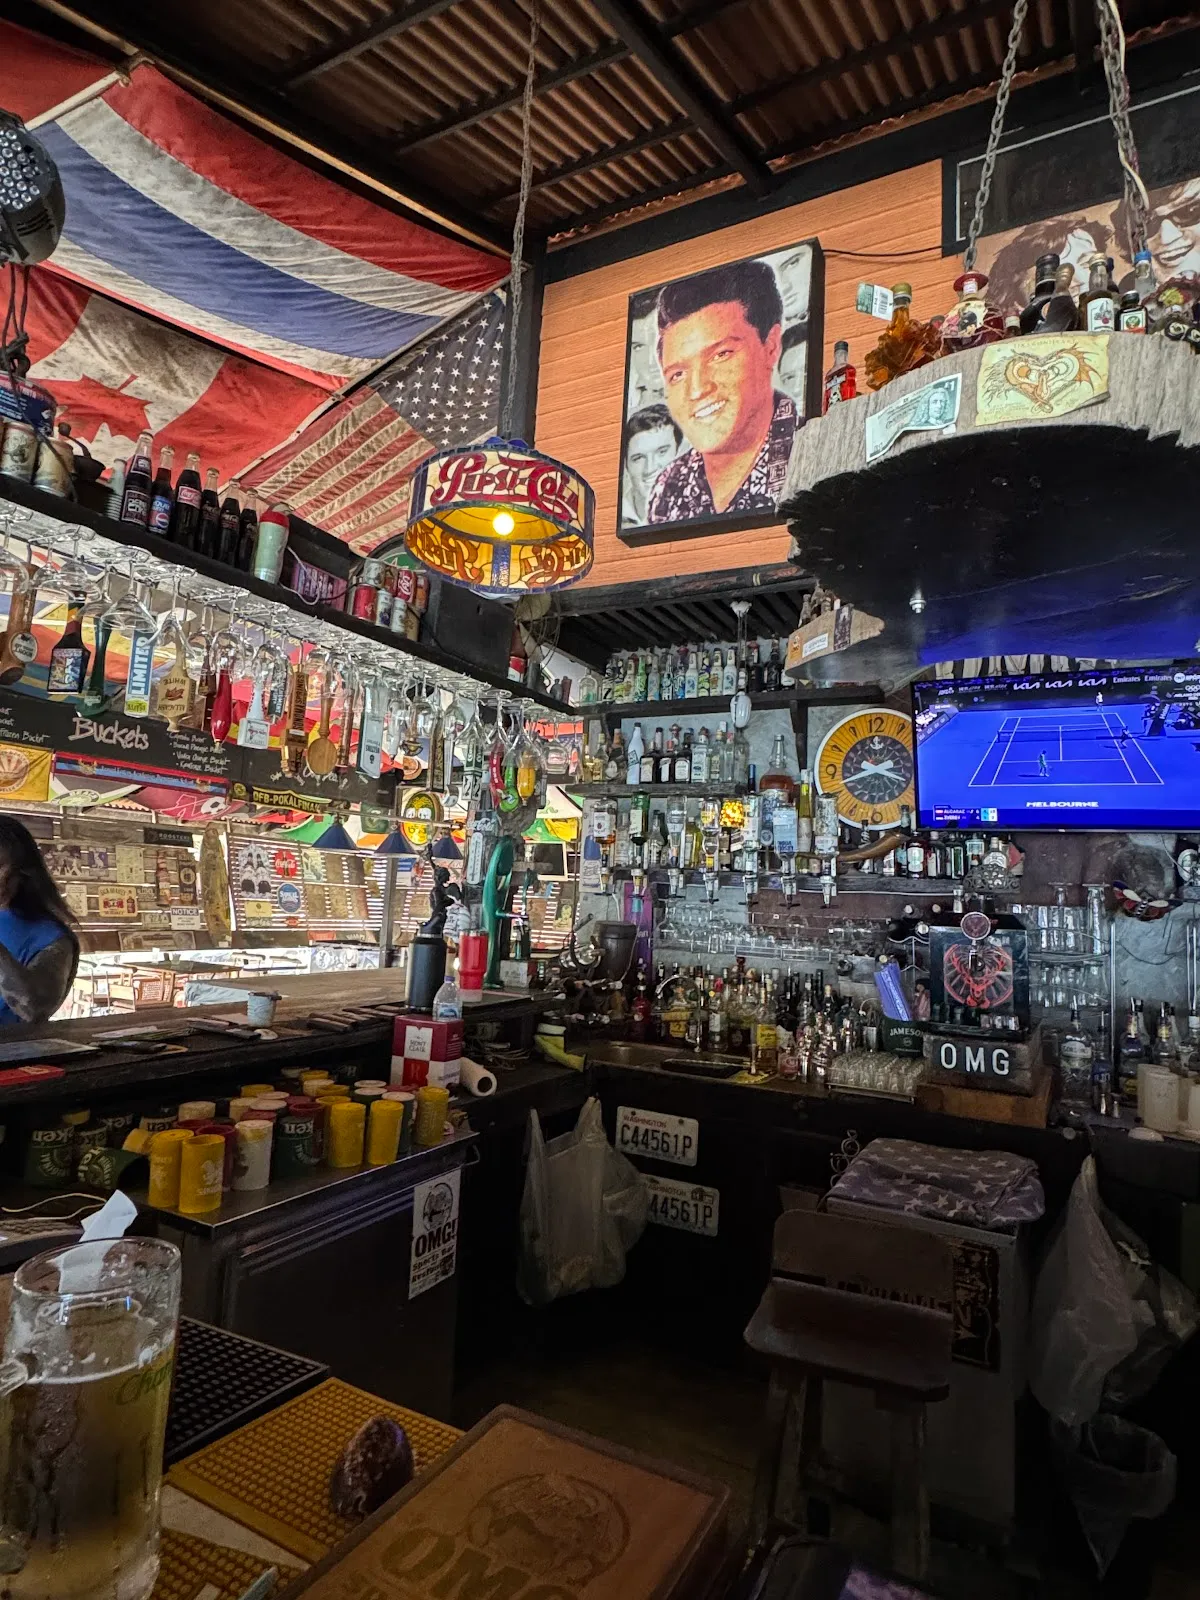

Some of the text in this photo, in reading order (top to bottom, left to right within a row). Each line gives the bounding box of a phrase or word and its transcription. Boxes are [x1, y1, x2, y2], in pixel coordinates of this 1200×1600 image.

[293, 674, 305, 705] SPRINGS
[1112, 675, 1141, 683] Emirates
[1145, 674, 1173, 682] Emirates
[68, 716, 150, 750] Buckets
[867, 716, 885, 733] 12
[825, 763, 837, 779] 9
[871, 807, 883, 824] 6
[172, 907, 200, 917] NOTICE
[623, 1115, 667, 1128] WASHINGTON
[620, 1123, 692, 1157] C44561P
[649, 1193, 713, 1230] 44561P
[414, 1219, 458, 1258] OMG!
[412, 1243, 455, 1272] Sports Bar
[382, 1527, 580, 1600] OM
